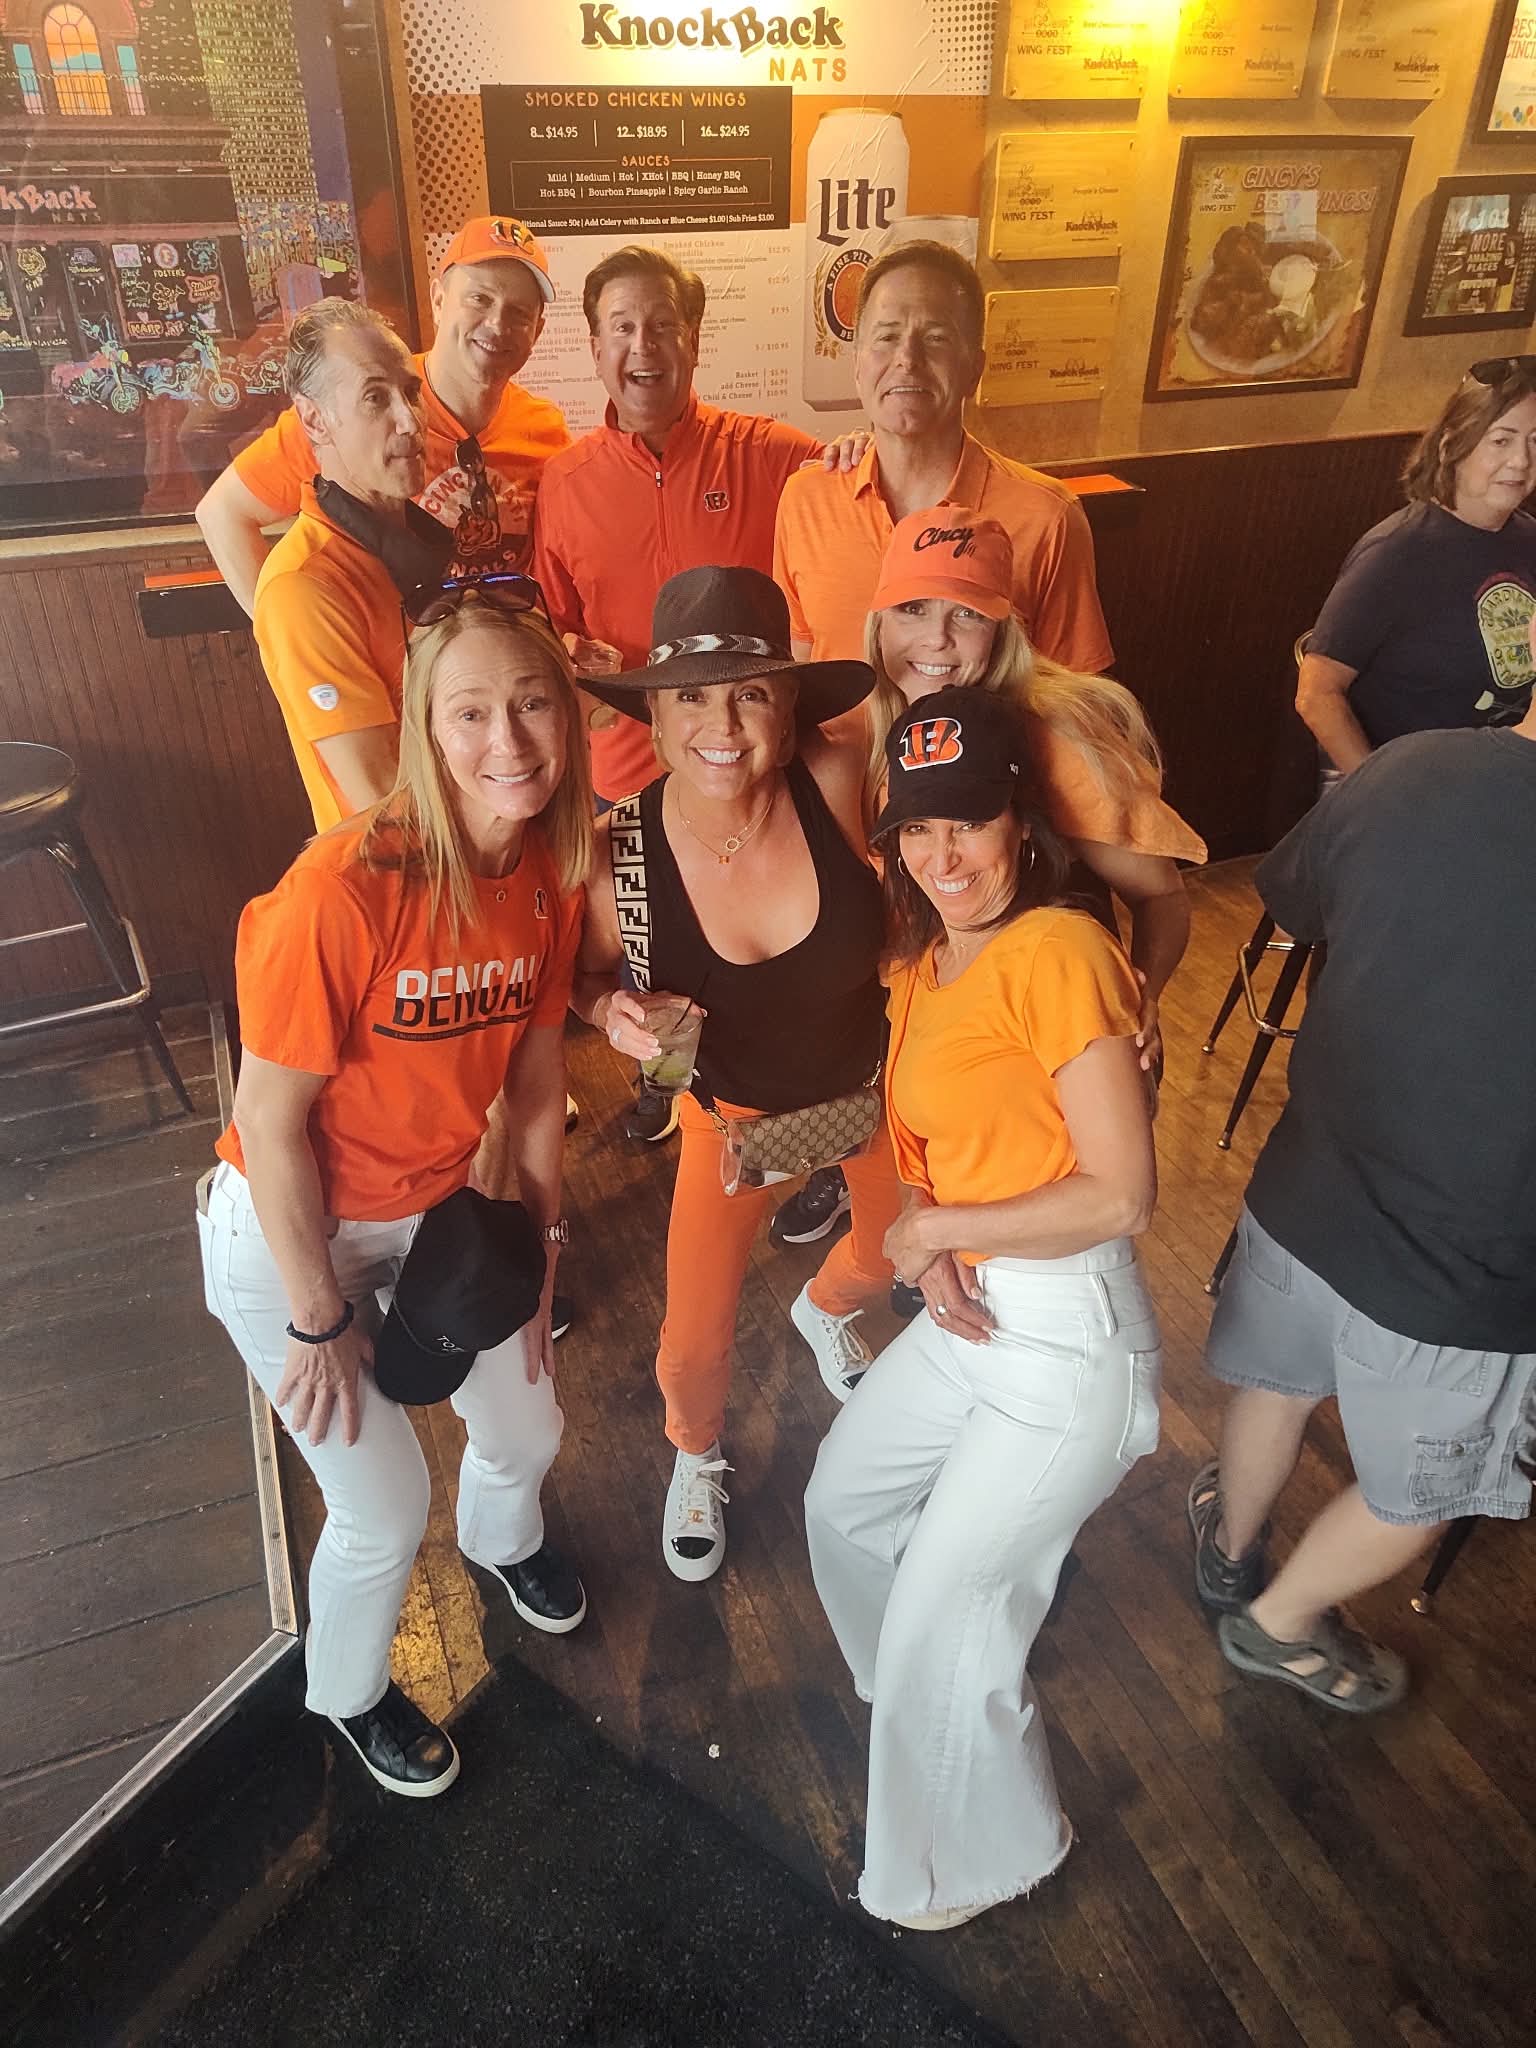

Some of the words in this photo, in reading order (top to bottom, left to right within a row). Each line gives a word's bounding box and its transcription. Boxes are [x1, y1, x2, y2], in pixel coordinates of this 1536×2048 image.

[579, 3, 845, 54] KnockBack
[1512, 18, 1536, 38] BES
[1017, 45, 1042, 55] WING
[1047, 45, 1072, 55] FEST
[1184, 45, 1207, 56] WING
[1211, 46, 1235, 56] FEST
[769, 57, 847, 82] NATS
[525, 92, 599, 107] SMOKED
[607, 92, 683, 107] CHICKEN
[690, 92, 747, 107] WINGS
[546, 125, 578, 139] $14.95
[636, 125, 668, 139] $18.95
[719, 124, 750, 138] $24.95
[621, 155, 670, 167] SAUCES
[547, 172, 568, 182] Mild
[576, 172, 611, 182] Medium
[618, 171, 634, 181] Hot
[641, 171, 664, 181] XHot
[671, 171, 689, 182] BBQ
[696, 171, 722, 181] Honey
[723, 170, 741, 181] BBQ
[540, 188, 556, 198] Hot
[557, 188, 576, 198] BBQ
[588, 187, 624, 197] Bourbon
[625, 186, 666, 197] Pineapple
[673, 186, 696, 197] Spicy
[697, 185, 722, 195] Garlic
[723, 185, 748, 194] Ranch
[816, 178, 896, 246] Lite
[1002, 211, 1026, 221] WING
[1030, 211, 1055, 220] FEST
[548, 219, 567, 228] Sauce
[584, 218, 598, 227] Add
[600, 218, 621, 227] Celery
[622, 217, 639, 226] with
[640, 216, 661, 225] Ranch
[662, 217, 669, 225] or
[670, 216, 685, 225] Blue
[686, 215, 708, 224] Cheese
[742, 213, 757, 222] Fries
[758, 213, 774, 222] $3.00
[694, 240, 725, 248] Chicken
[1471, 232, 1507, 252] MORE
[1466, 262, 1499, 273] PLACES
[1016, 360, 1040, 369] FEST
[735, 371, 758, 379] Basket
[735, 380, 759, 389] Cheese
[728, 391, 753, 399] Cheese
[913, 527, 975, 558] Cincy
[392, 954, 537, 1028] BENGAL
